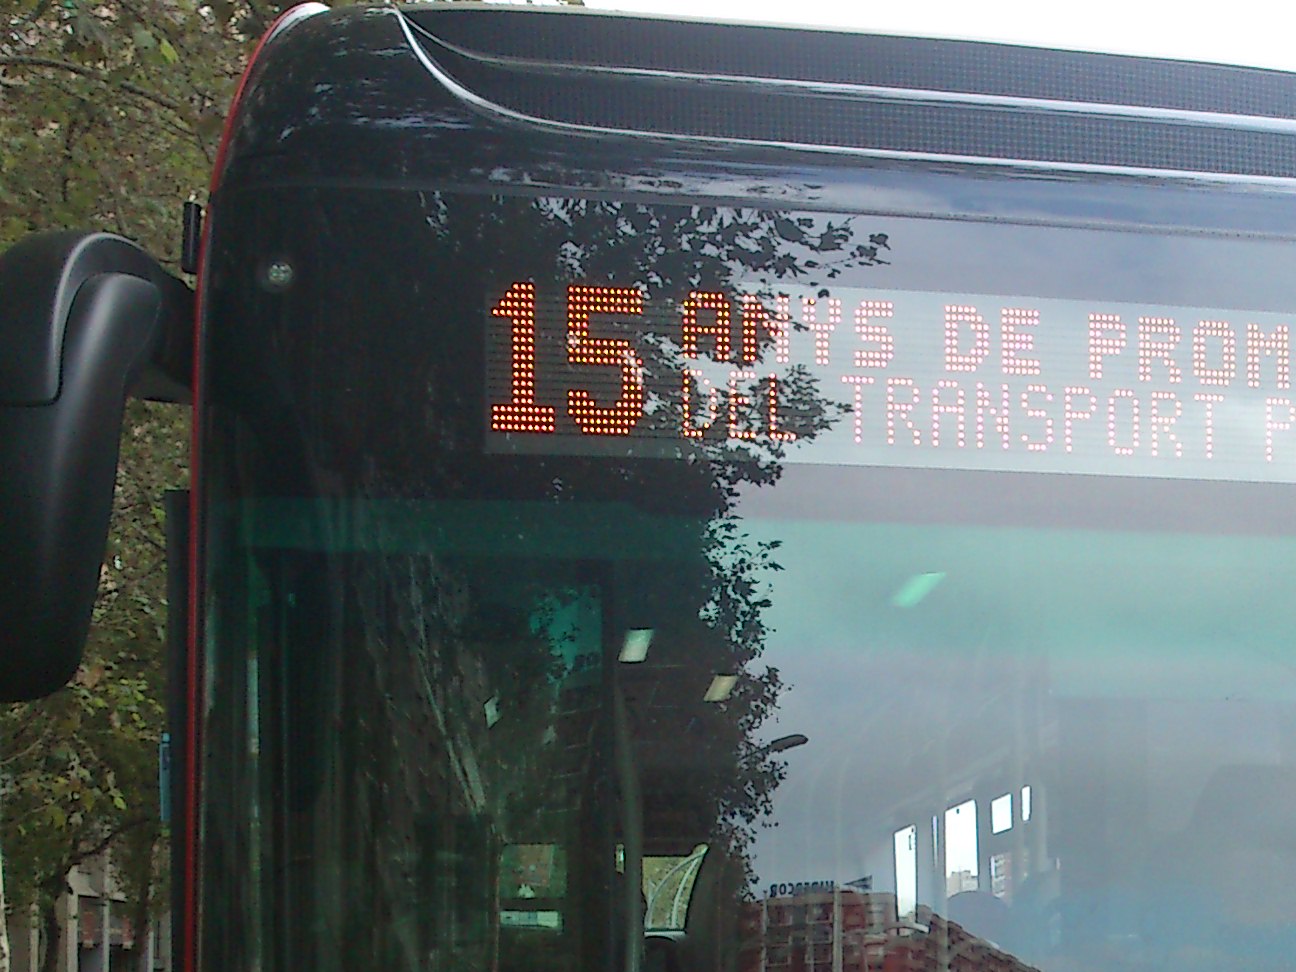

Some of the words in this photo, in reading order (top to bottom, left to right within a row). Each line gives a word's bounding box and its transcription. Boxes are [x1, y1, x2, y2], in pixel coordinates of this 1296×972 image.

[491, 281, 643, 435] 15
[683, 291, 894, 368] ANYS
[945, 304, 1041, 376] DE
[683, 368, 798, 441] DEL
[841, 375, 1225, 459] TRANSPORT
